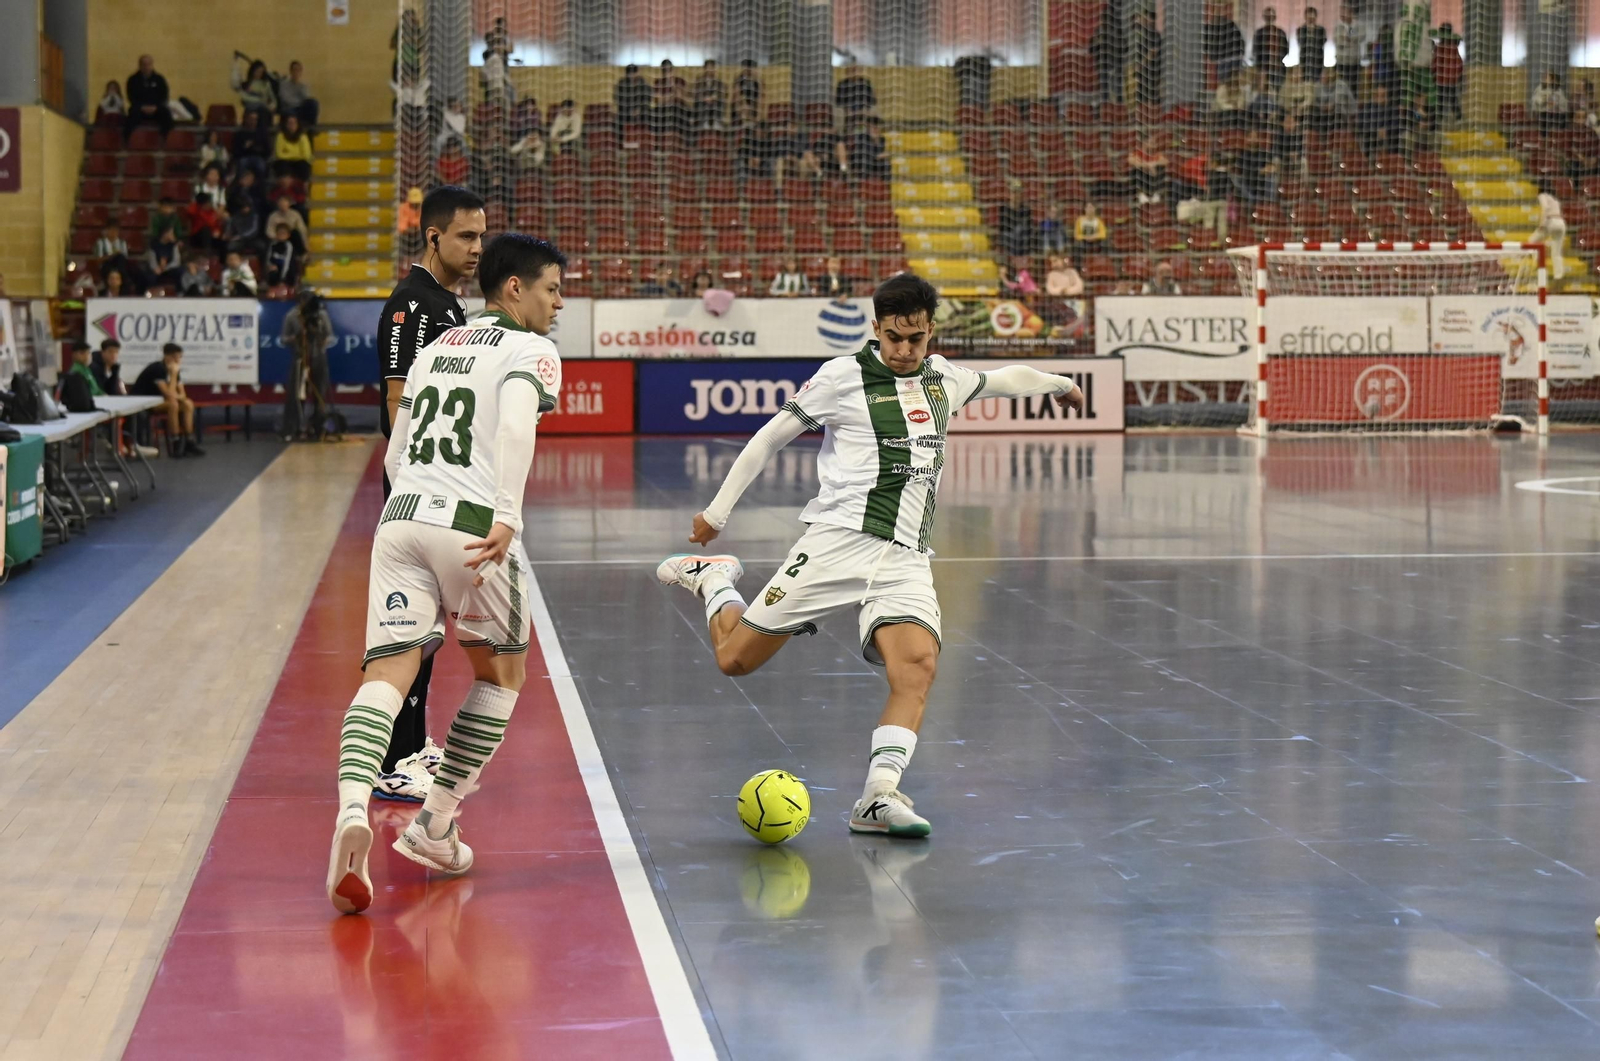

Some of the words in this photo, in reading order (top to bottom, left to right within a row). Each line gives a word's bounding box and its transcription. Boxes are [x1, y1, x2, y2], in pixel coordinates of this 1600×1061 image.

[118, 313, 227, 342] COPYFAX
[414, 314, 429, 357] WÜRTH
[1105, 317, 1248, 343] MASTER
[1279, 326, 1393, 353] efficold
[390, 325, 401, 368] WÜRTH
[430, 356, 476, 374] MURILO
[566, 393, 604, 415] SALA
[408, 385, 476, 468] 23
[785, 553, 809, 578] 2
